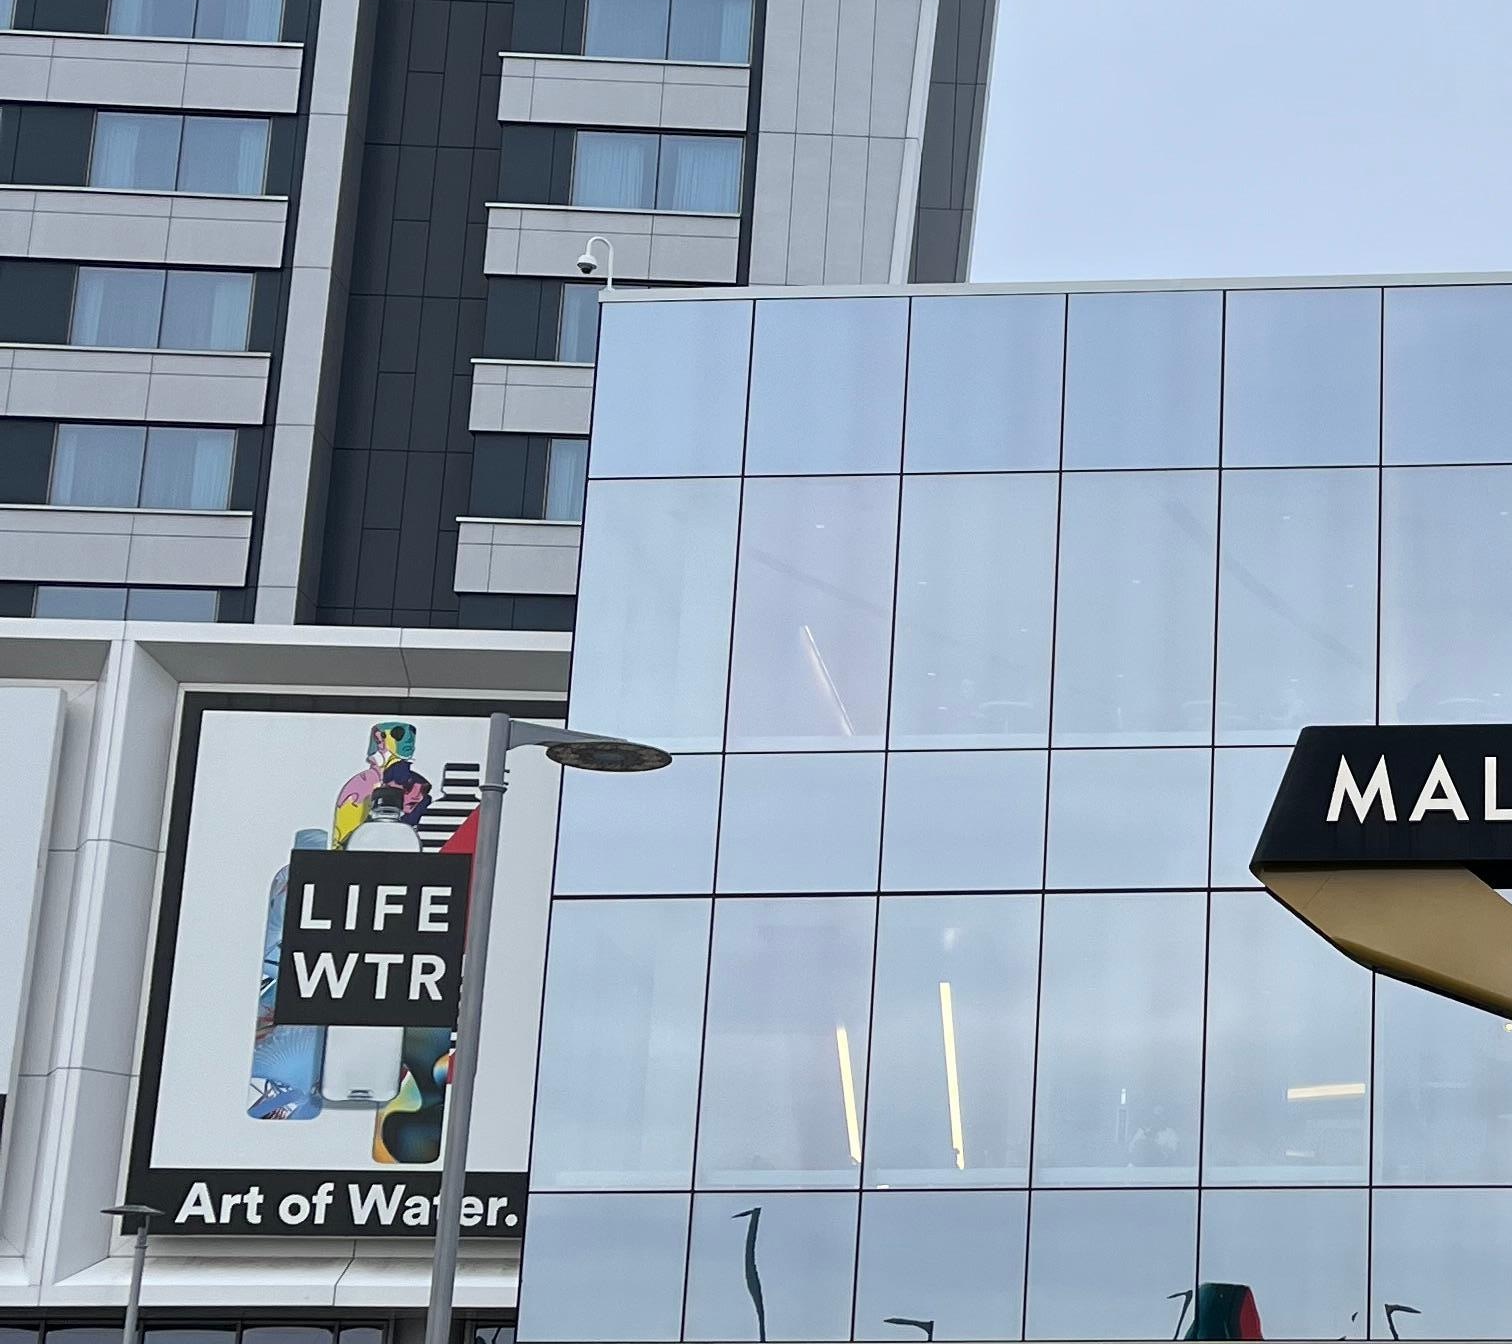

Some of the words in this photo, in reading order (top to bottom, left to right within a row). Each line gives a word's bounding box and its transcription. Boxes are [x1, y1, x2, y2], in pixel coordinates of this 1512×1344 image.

[299, 883, 453, 932] LIFE
[293, 952, 447, 1001] WTR
[174, 1182, 264, 1224] Art
[278, 1182, 335, 1225] of
[348, 1183, 519, 1226] Waer.
